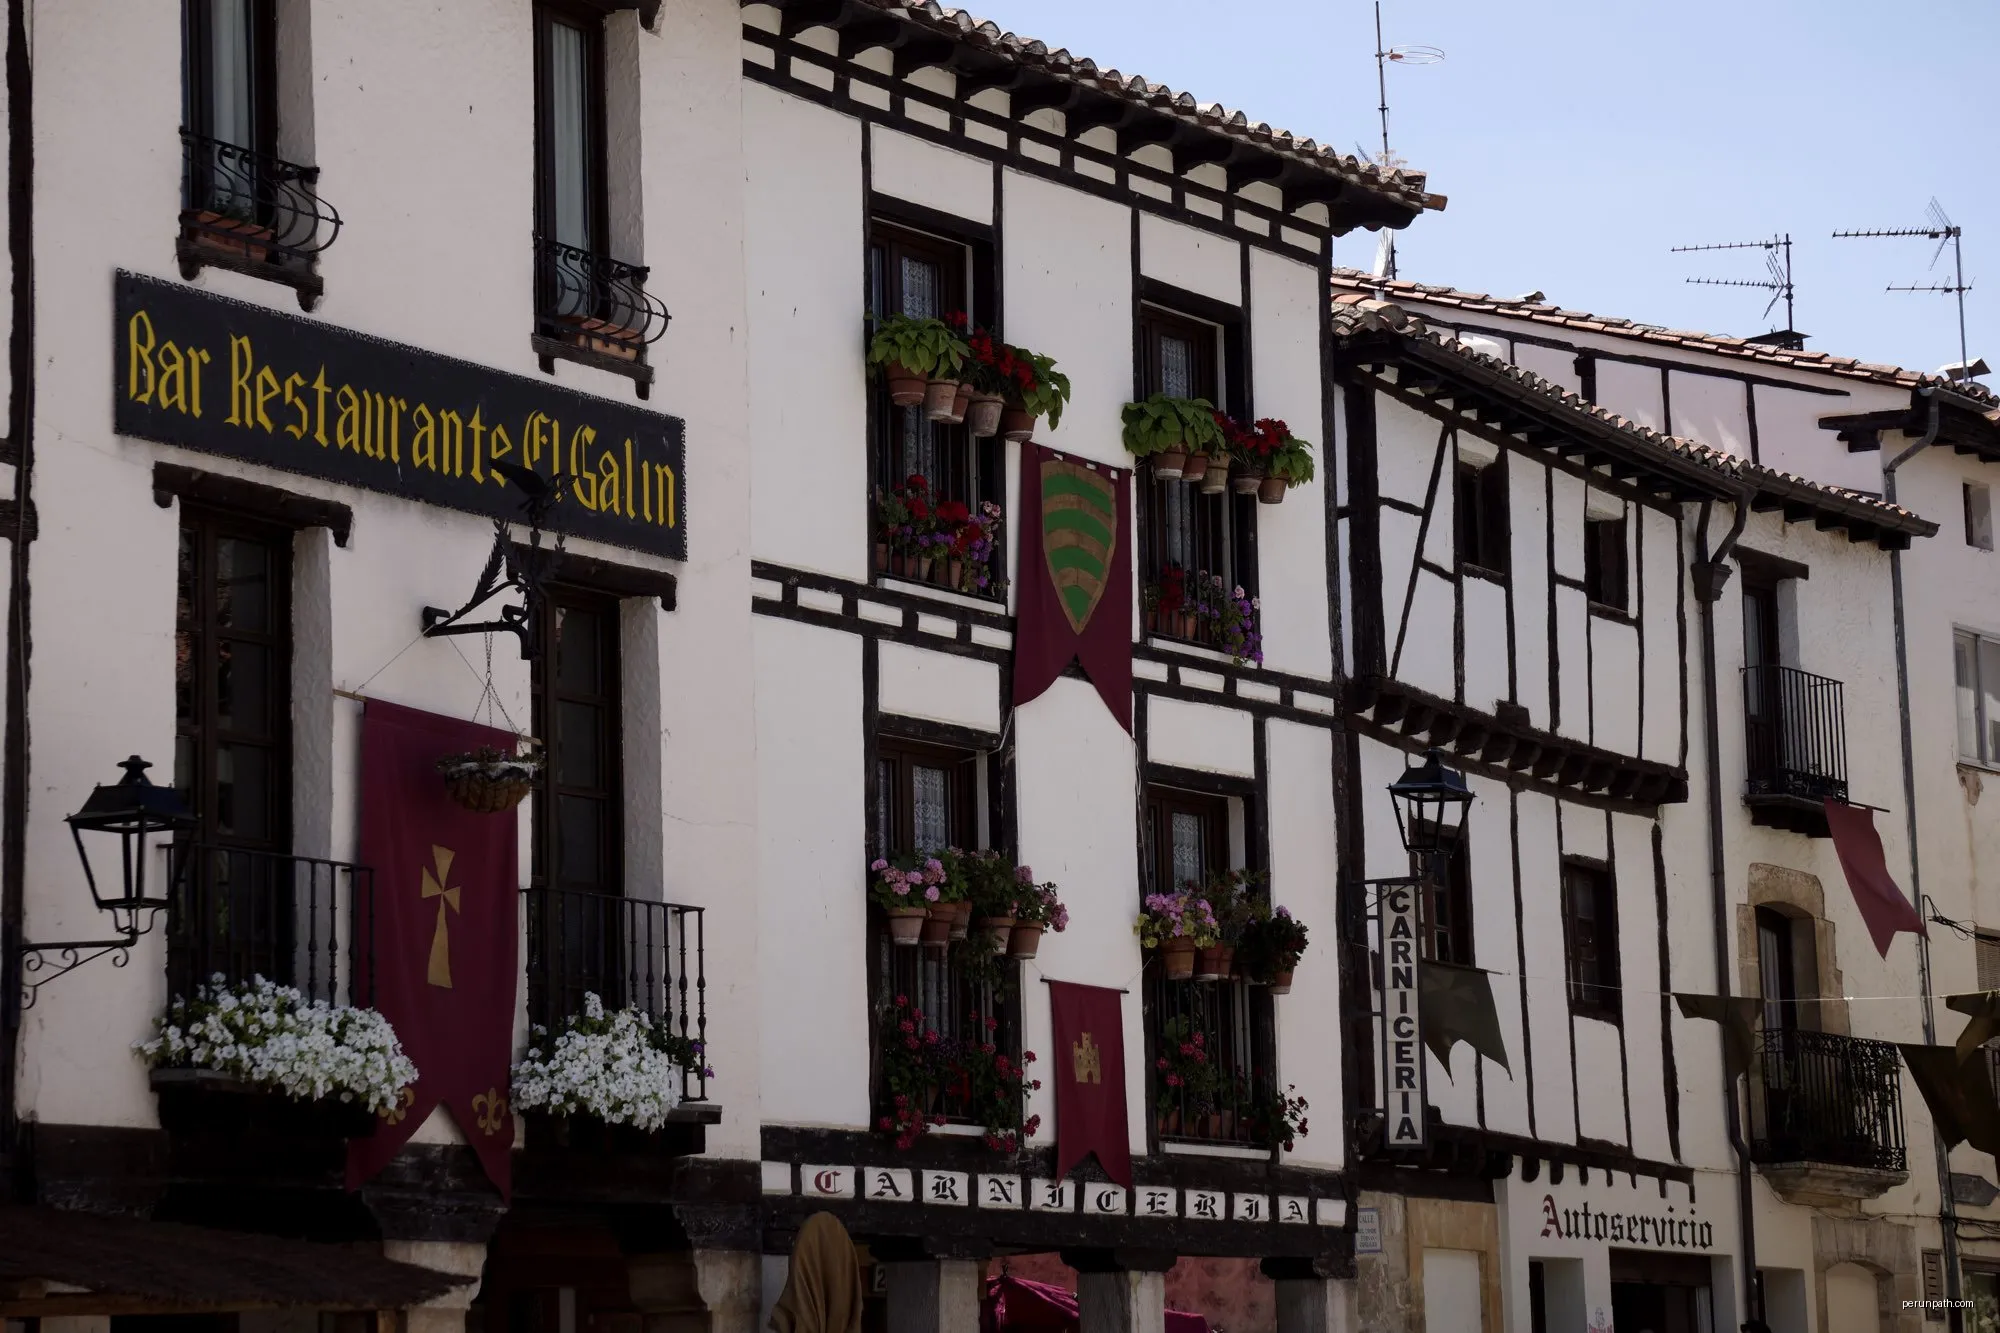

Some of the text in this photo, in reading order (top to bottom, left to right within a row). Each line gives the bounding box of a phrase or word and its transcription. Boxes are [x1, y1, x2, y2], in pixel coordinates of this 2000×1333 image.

[128, 309, 211, 419] Bar
[223, 332, 513, 488] Restaurante
[1389, 890, 1418, 1141] CARNICERIA
[813, 1170, 1304, 1222] CARNICERIA
[1540, 1193, 1713, 1250] Autoservicio
